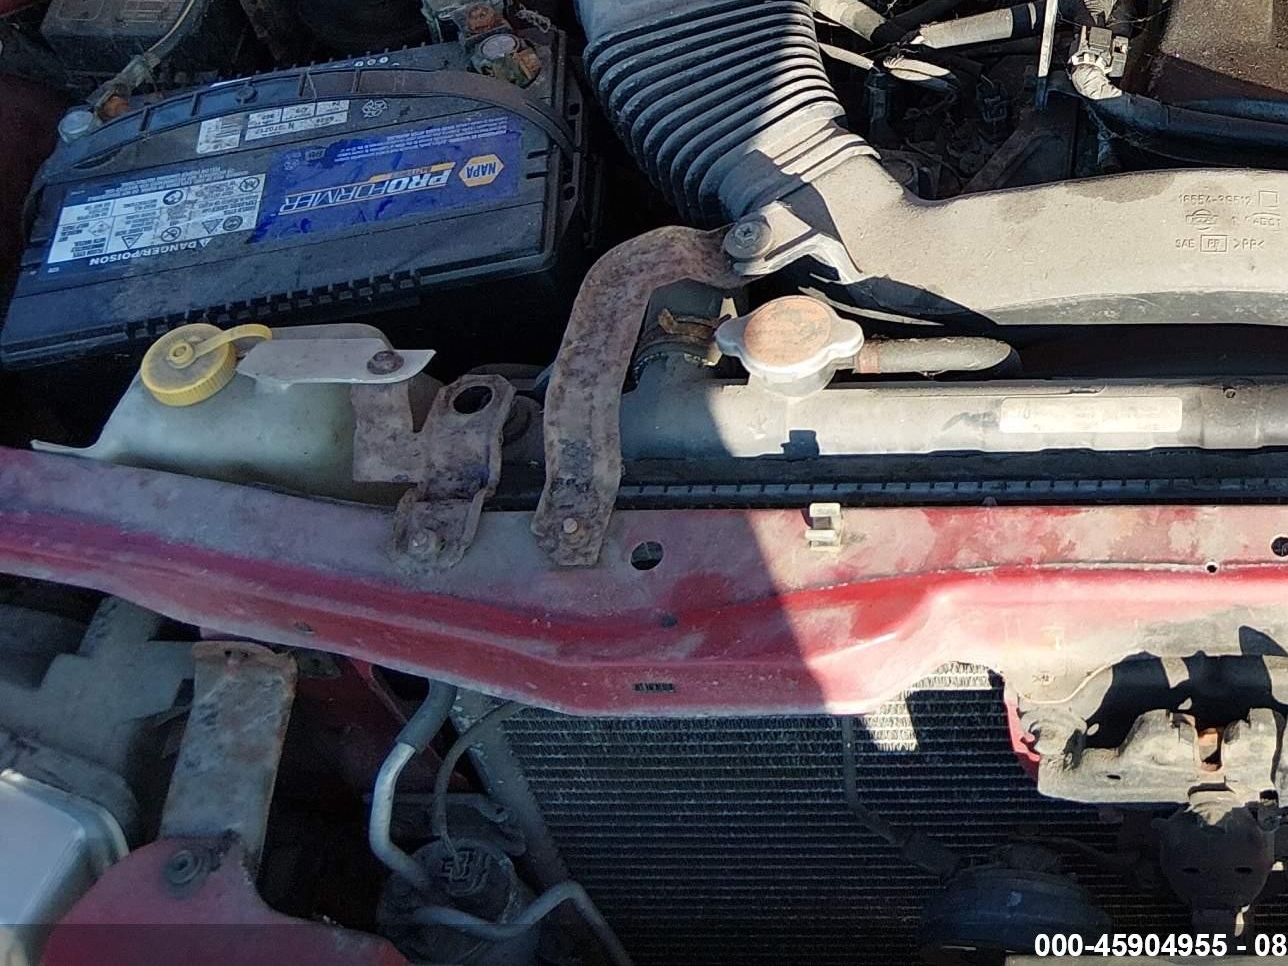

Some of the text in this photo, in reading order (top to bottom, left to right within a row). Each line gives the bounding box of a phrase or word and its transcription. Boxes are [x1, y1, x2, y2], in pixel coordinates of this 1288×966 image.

[466, 162, 497, 179] NAPA
[278, 168, 453, 215] PROFORMER
[89, 238, 198, 266] DANGER/POISON
[1175, 238, 1195, 249] SAE
